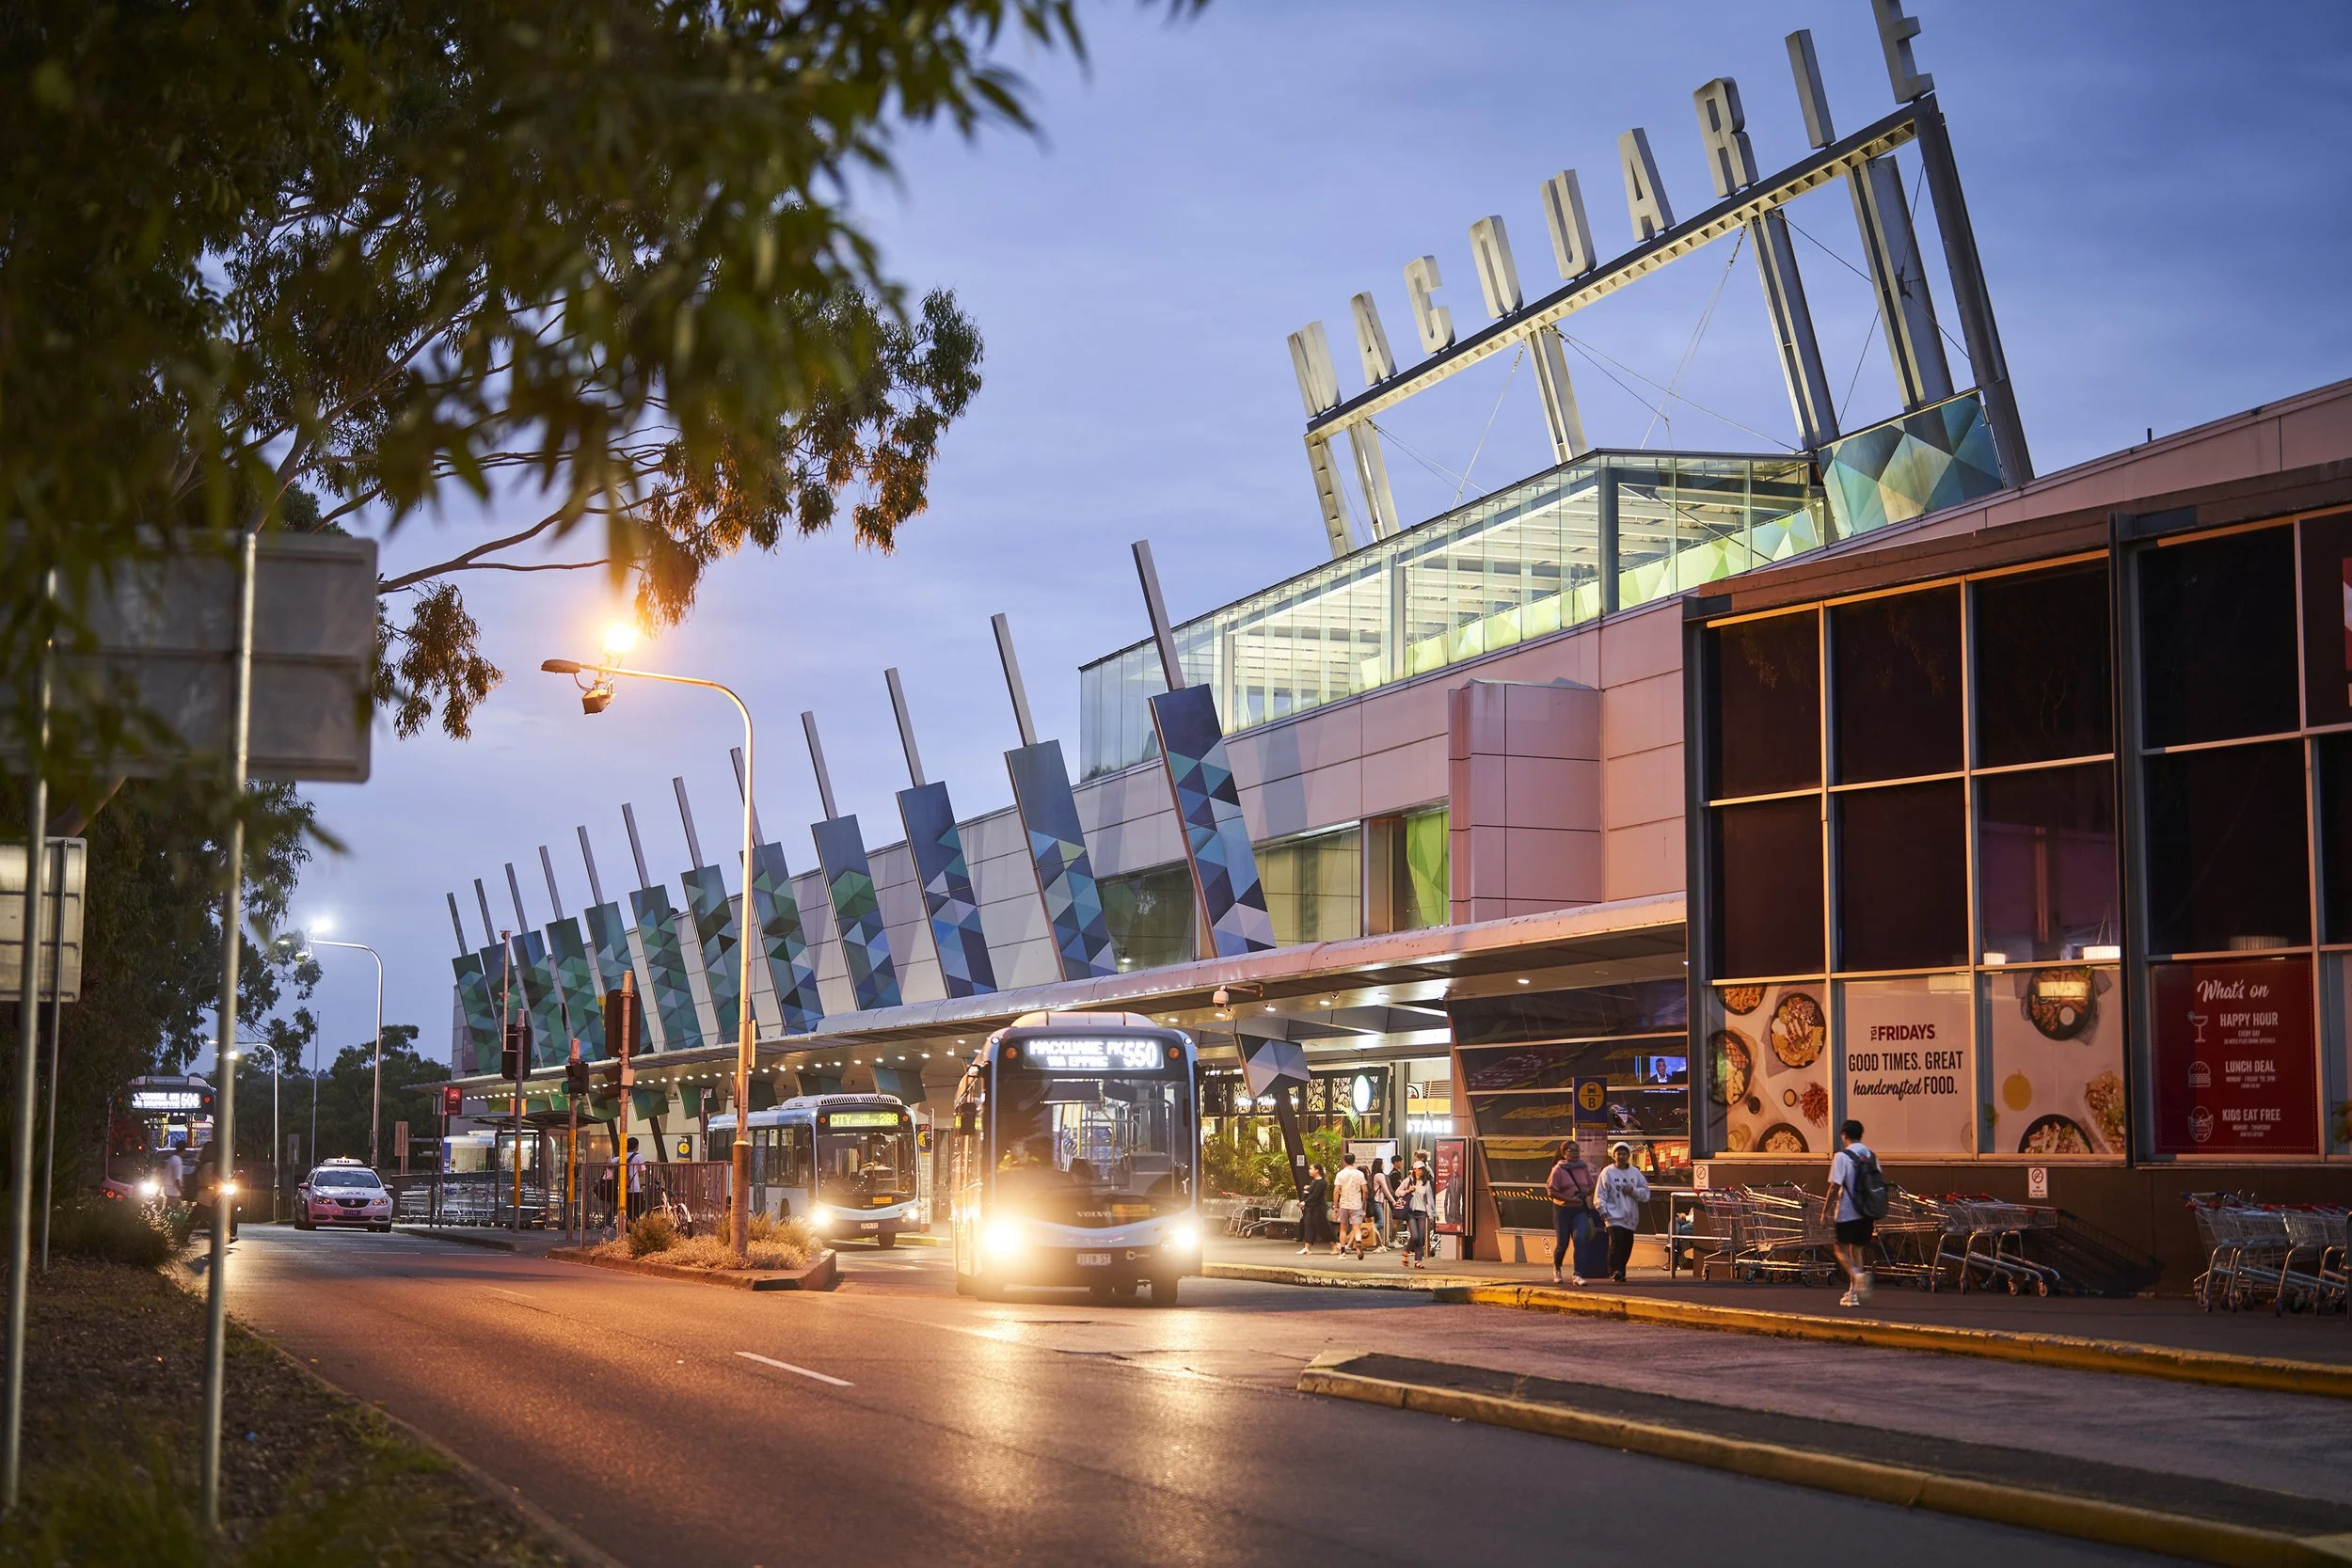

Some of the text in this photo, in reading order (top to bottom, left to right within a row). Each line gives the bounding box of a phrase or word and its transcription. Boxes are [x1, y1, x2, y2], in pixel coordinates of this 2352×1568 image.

[1287, 0, 1934, 417] MACQUARIE
[2197, 979, 2270, 1003] What's on
[2220, 1012, 2278, 1027] HAPPY HOUR
[1878, 1023, 1935, 1040] FRIDAYS
[1123, 1040, 1157, 1068] 550
[1849, 1051, 1963, 1071] GOOD TIMES. GREAT
[2225, 1059, 2276, 1072] LUNCH DEAL
[1853, 1076, 1958, 1101] handcrafted FOOD.
[1588, 1098, 1596, 1108] B
[830, 1114, 851, 1125] CITY
[880, 1113, 898, 1124] 288
[2222, 1109, 2281, 1121] KIDS EAT FREE
